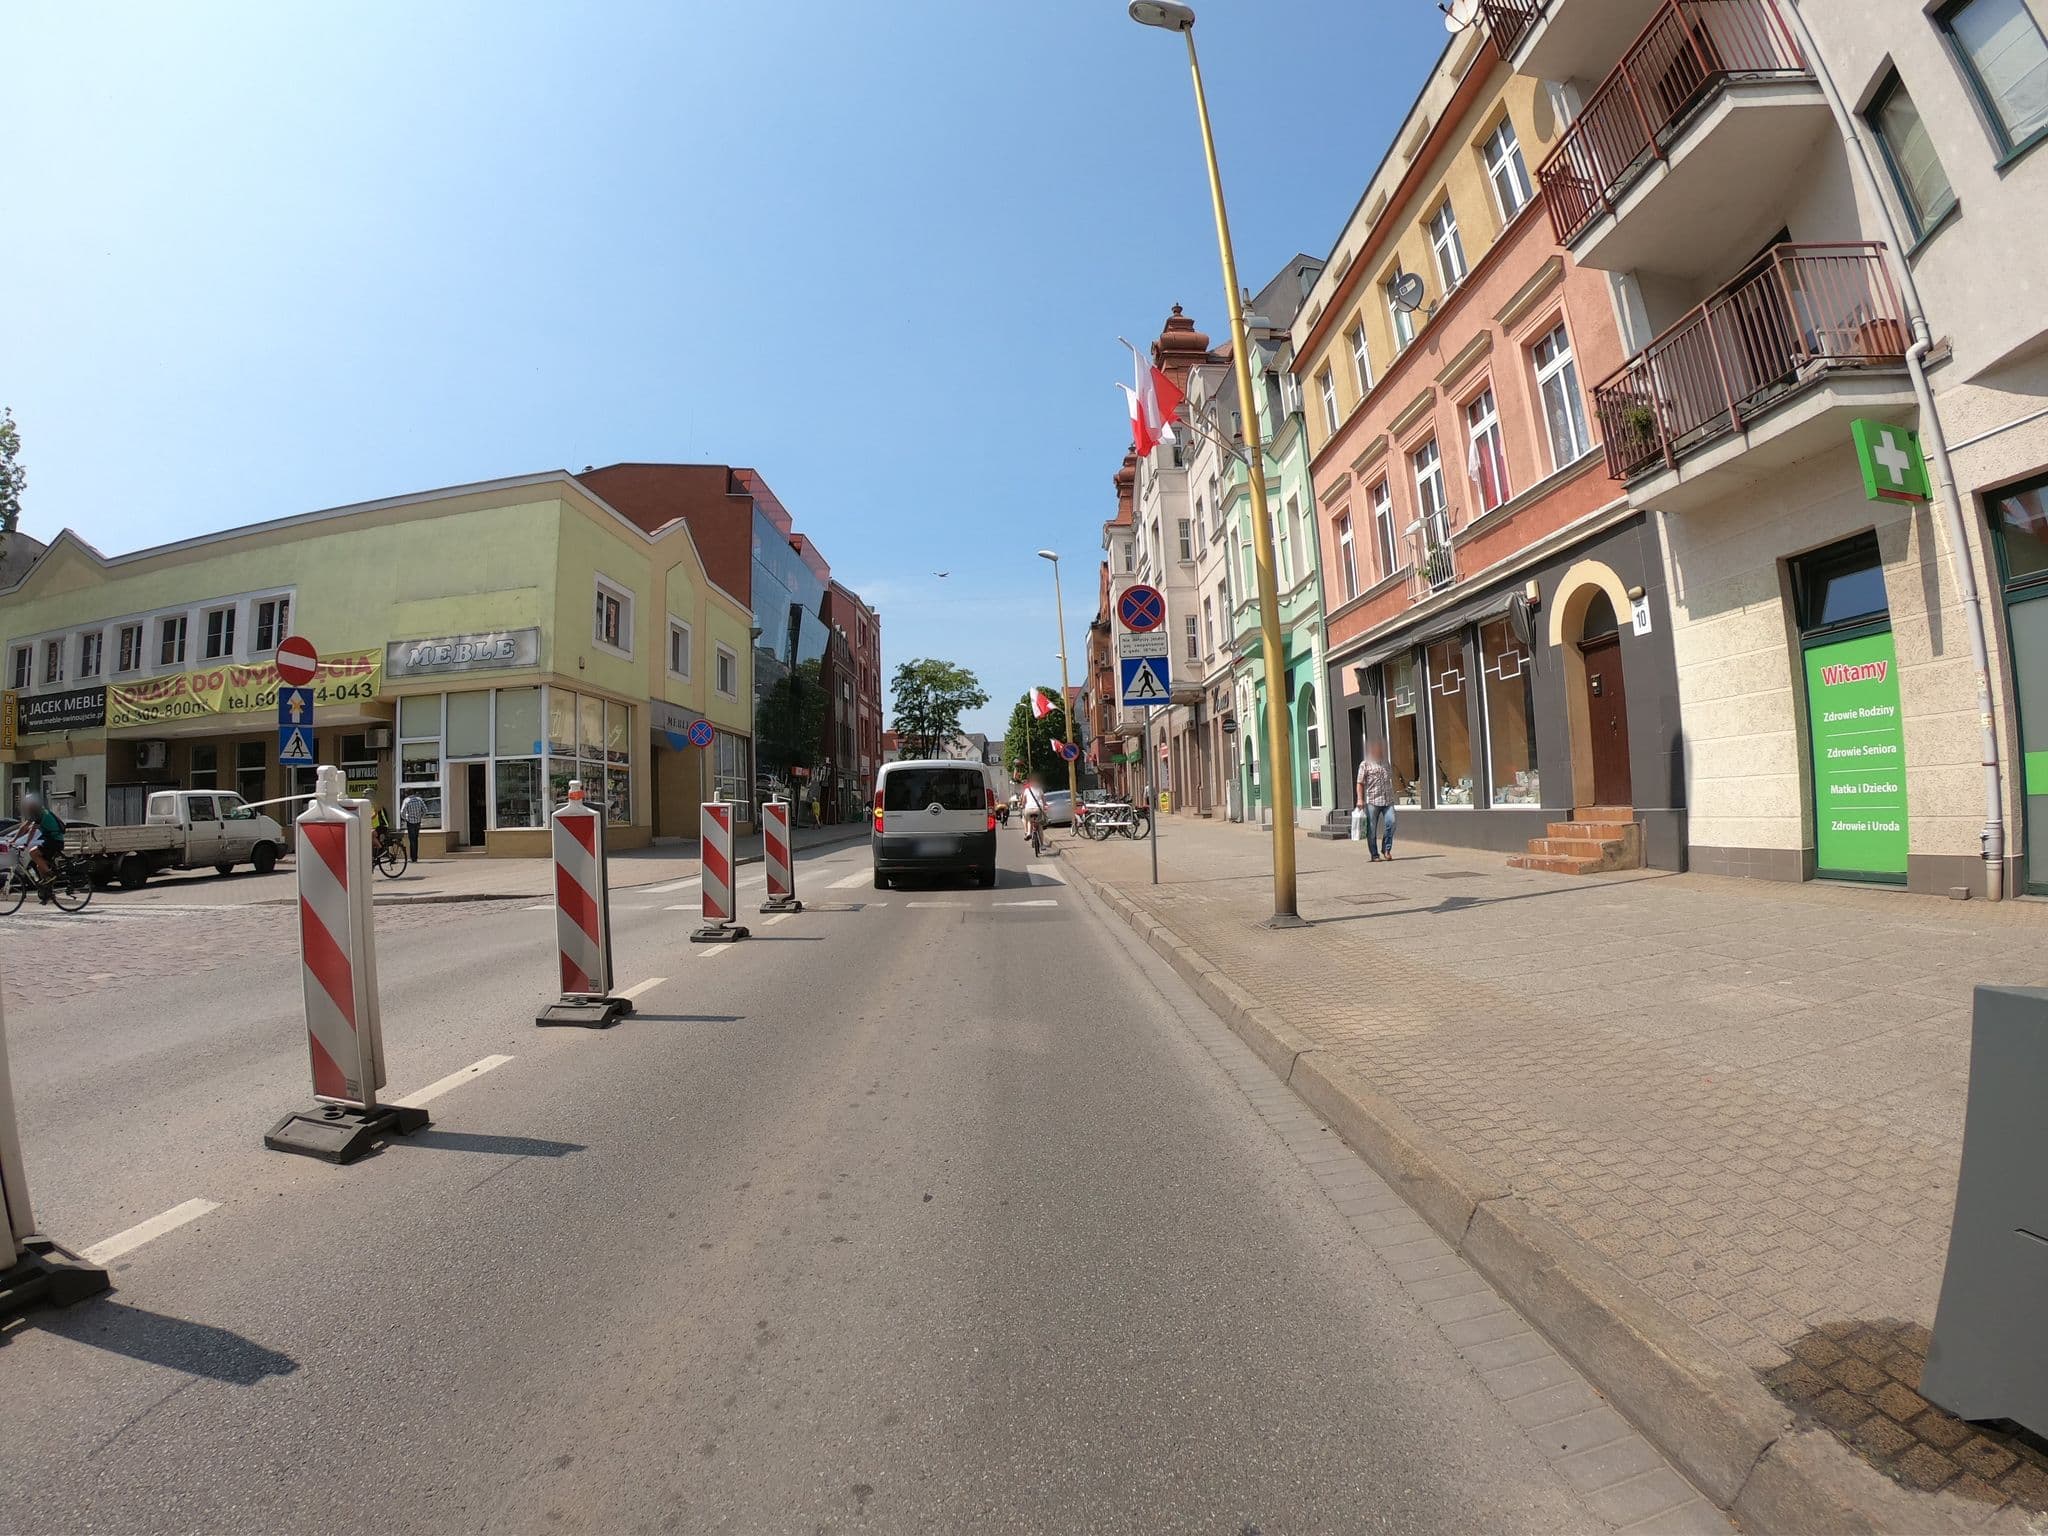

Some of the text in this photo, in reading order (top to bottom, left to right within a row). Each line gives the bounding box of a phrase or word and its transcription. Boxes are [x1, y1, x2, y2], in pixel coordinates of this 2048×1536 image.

[1636, 609, 1647, 628] 10
[406, 638, 516, 667] MEBLE
[192, 671, 224, 693] DO
[230, 656, 373, 688] WYNĘCIA
[1821, 660, 1888, 686] Witamy
[29, 693, 105, 715] JACEK MEBLE
[1823, 705, 1895, 722] Zdrowie Rodziny
[4, 694, 14, 746] MEBLE
[112, 710, 129, 724] od
[1827, 744, 1897, 758] Zdrowie Seniora
[1830, 783, 1857, 794] Matka
[1862, 782, 1898, 793] Dziecko
[1831, 820, 1867, 831] Zdrowie
[1872, 820, 1900, 832] Uroda
